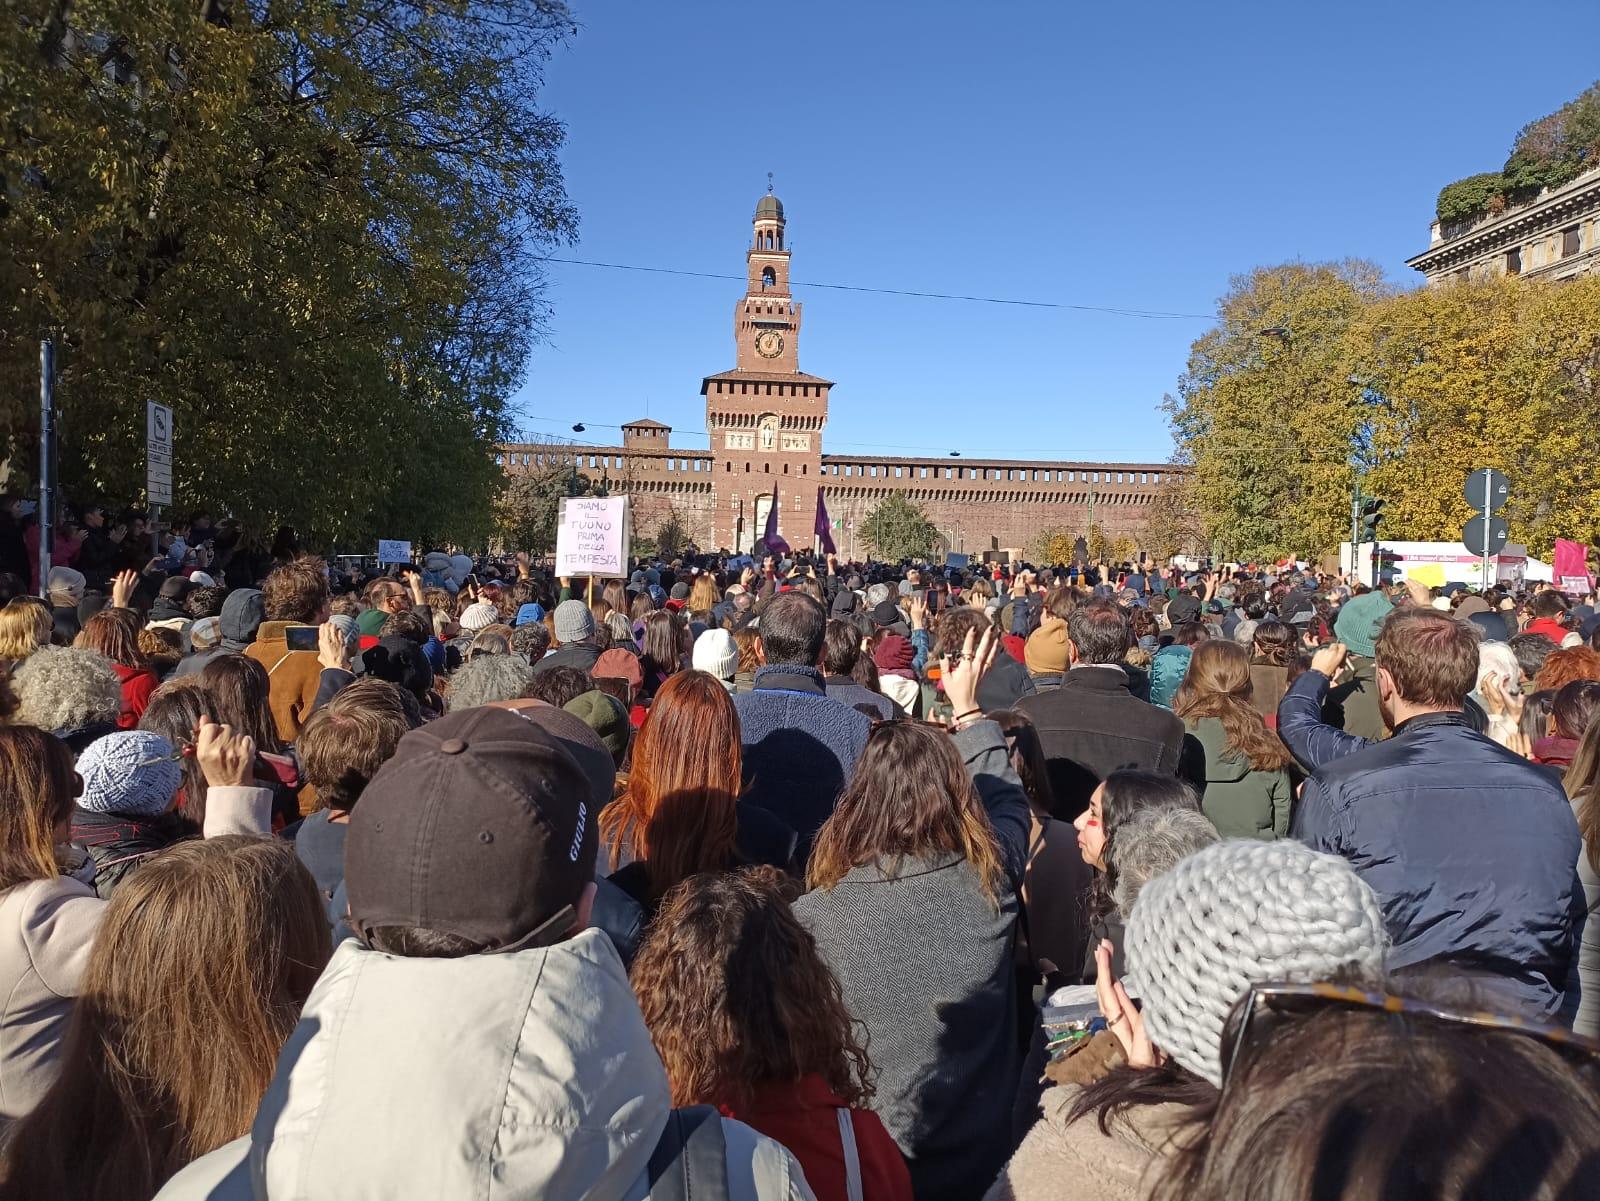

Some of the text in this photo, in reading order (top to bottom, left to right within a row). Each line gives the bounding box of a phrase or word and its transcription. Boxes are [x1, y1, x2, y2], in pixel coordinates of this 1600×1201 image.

[576, 501, 608, 511] SIAMO
[571, 520, 612, 531] TUONO
[577, 531, 605, 542] PRIMA
[578, 543, 605, 551] DELLA
[564, 553, 618, 567] TEMPESTA
[570, 801, 587, 861] GIULIO
